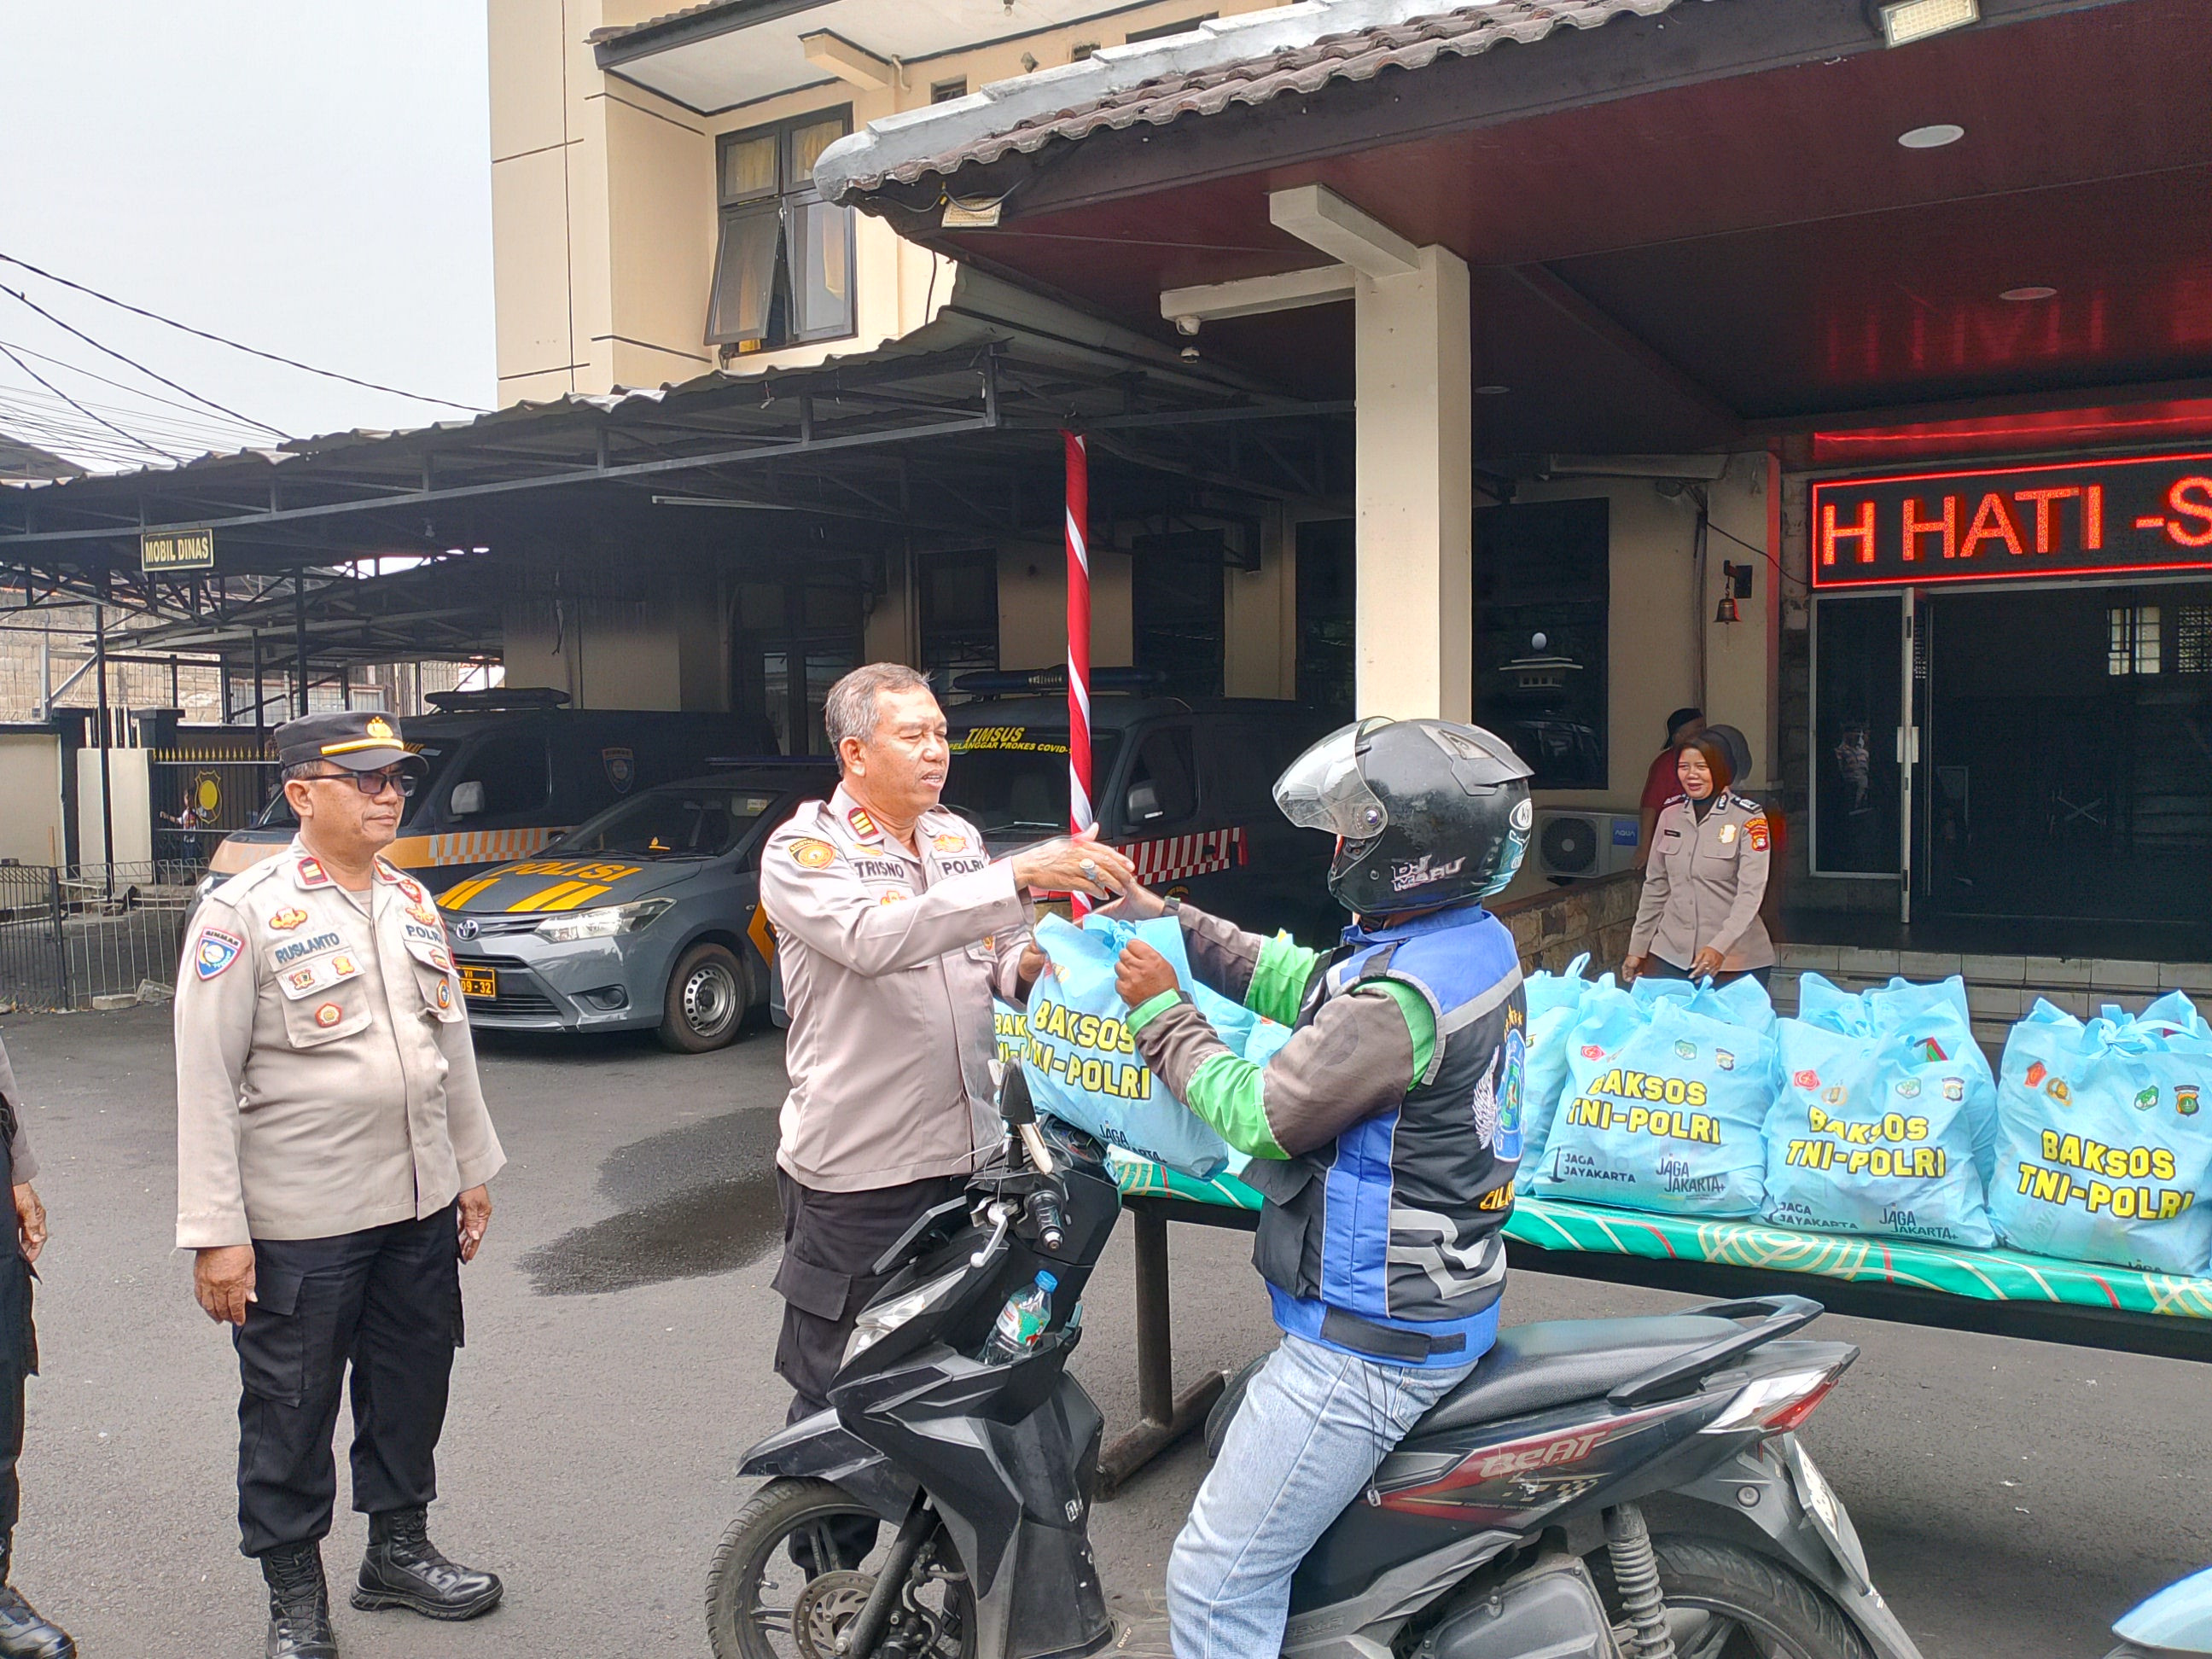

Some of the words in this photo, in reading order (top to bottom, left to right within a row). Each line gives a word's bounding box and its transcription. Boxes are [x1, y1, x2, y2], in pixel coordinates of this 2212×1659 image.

[1823, 501, 1875, 565] H
[1902, 486, 2101, 561] HATI
[145, 539, 176, 563] MOBIL
[178, 536, 209, 561] DINAS
[965, 727, 1025, 743] TIMSUS
[999, 742, 1036, 750] PROKES
[486, 861, 643, 882] POLISI
[854, 860, 905, 879] TRISNO
[941, 859, 984, 876] POLRI
[274, 932, 341, 964] RUSLANTO
[1034, 998, 1135, 1055] BAKSOS
[1586, 1068, 1708, 1107] BAKSOS
[1566, 1097, 1721, 1145] TNI-POLRI
[1807, 1104, 1930, 1145] BAKSOS
[1564, 1153, 1595, 1166] JAGA
[1785, 1138, 1947, 1179] TNI-POLRI
[2040, 1128, 2176, 1181] BAKSOS
[1563, 1167, 1637, 1184] JAYAKARTA
[1656, 1156, 1690, 1178] JAGA
[2017, 1161, 2196, 1220] TNI-POLRI
[1779, 1202, 1812, 1215] JAGA
[1879, 1207, 1917, 1227] JAGA
[1778, 1214, 1859, 1230] JAYAKARTA
